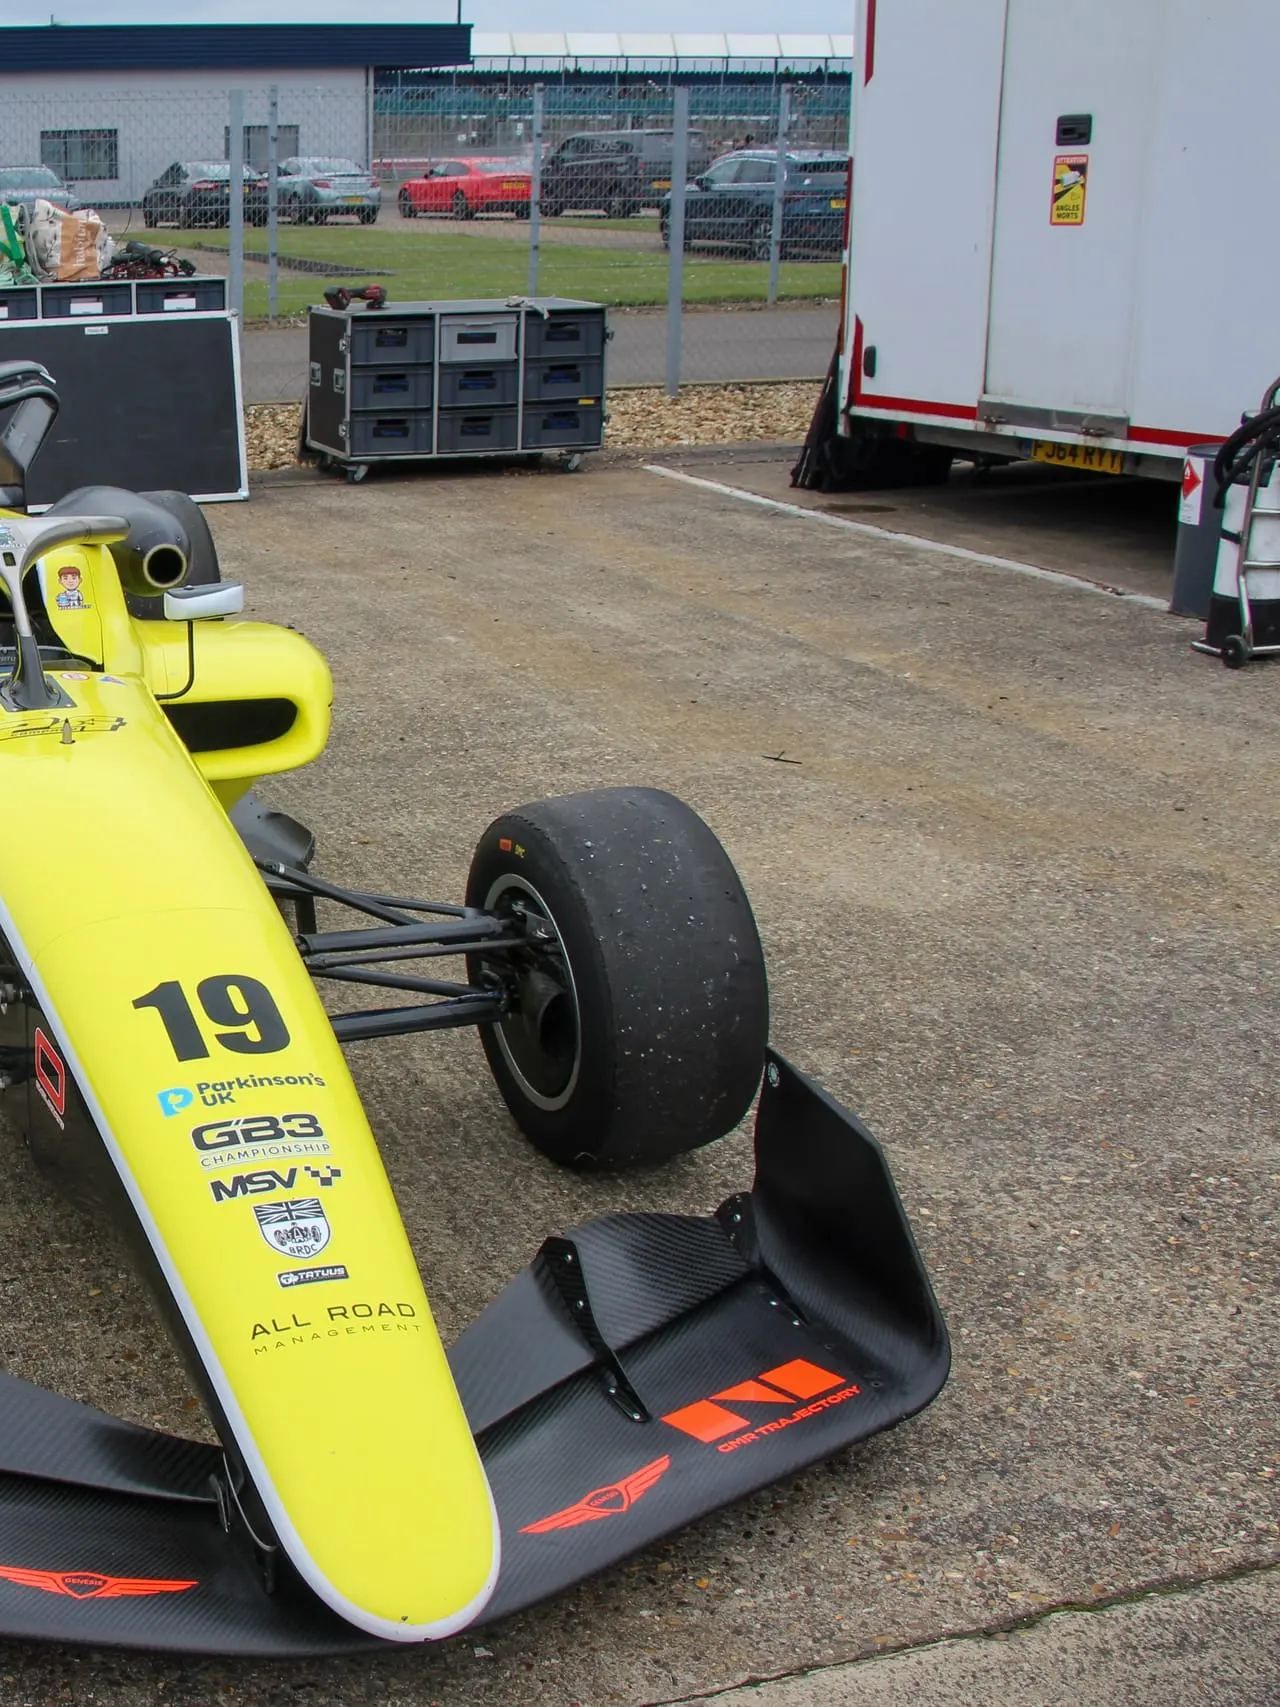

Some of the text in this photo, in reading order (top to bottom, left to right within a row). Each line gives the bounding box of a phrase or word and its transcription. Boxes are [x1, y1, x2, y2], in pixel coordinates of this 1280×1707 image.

[1055, 204, 1081, 212] ANGLES
[1056, 212, 1079, 220] MORTS
[1033, 441, 1078, 463] FJ64
[132, 974, 291, 1062] 19
[196, 1072, 326, 1095] Parkinson's
[201, 1091, 236, 1107] UK
[191, 1113, 324, 1151] GB3
[200, 1143, 331, 1167] CHAMPIONSHIP
[210, 1167, 298, 1202] MSV
[289, 1243, 318, 1255] BRDC
[298, 1267, 345, 1280] TATUUS
[251, 1302, 416, 1340] ALL ROAD
[254, 1323, 422, 1356] MANAGEMENT
[716, 1384, 861, 1453] GMR TRAJECTORY
[63, 1577, 105, 1587] GENESIS
